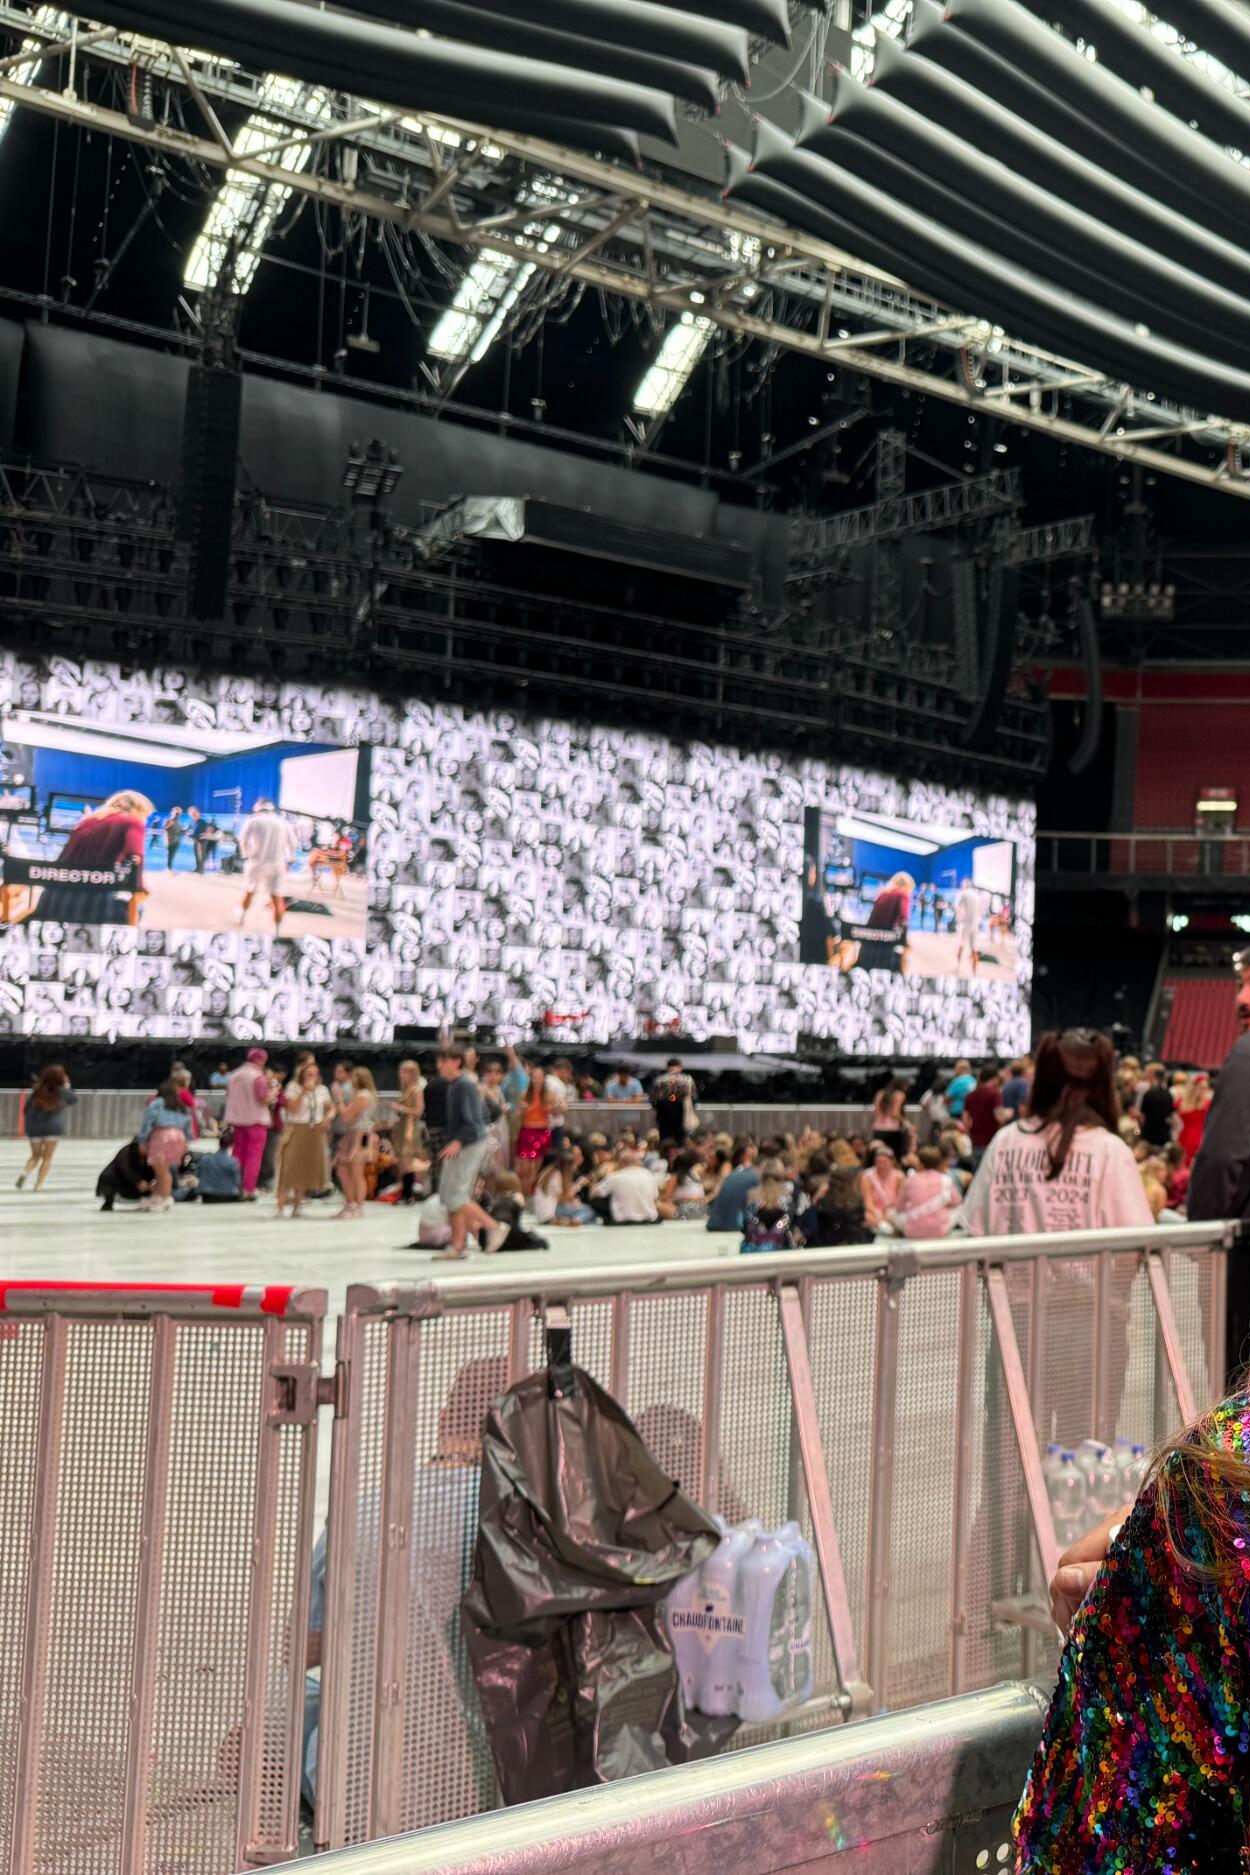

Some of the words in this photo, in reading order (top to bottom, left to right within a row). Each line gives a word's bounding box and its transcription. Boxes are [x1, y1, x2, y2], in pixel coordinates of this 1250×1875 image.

[29, 866, 115, 884] DIRECTOR
[1045, 1188, 1090, 1205] 2024
[672, 1611, 744, 1635] CHAUDFONTAINE
